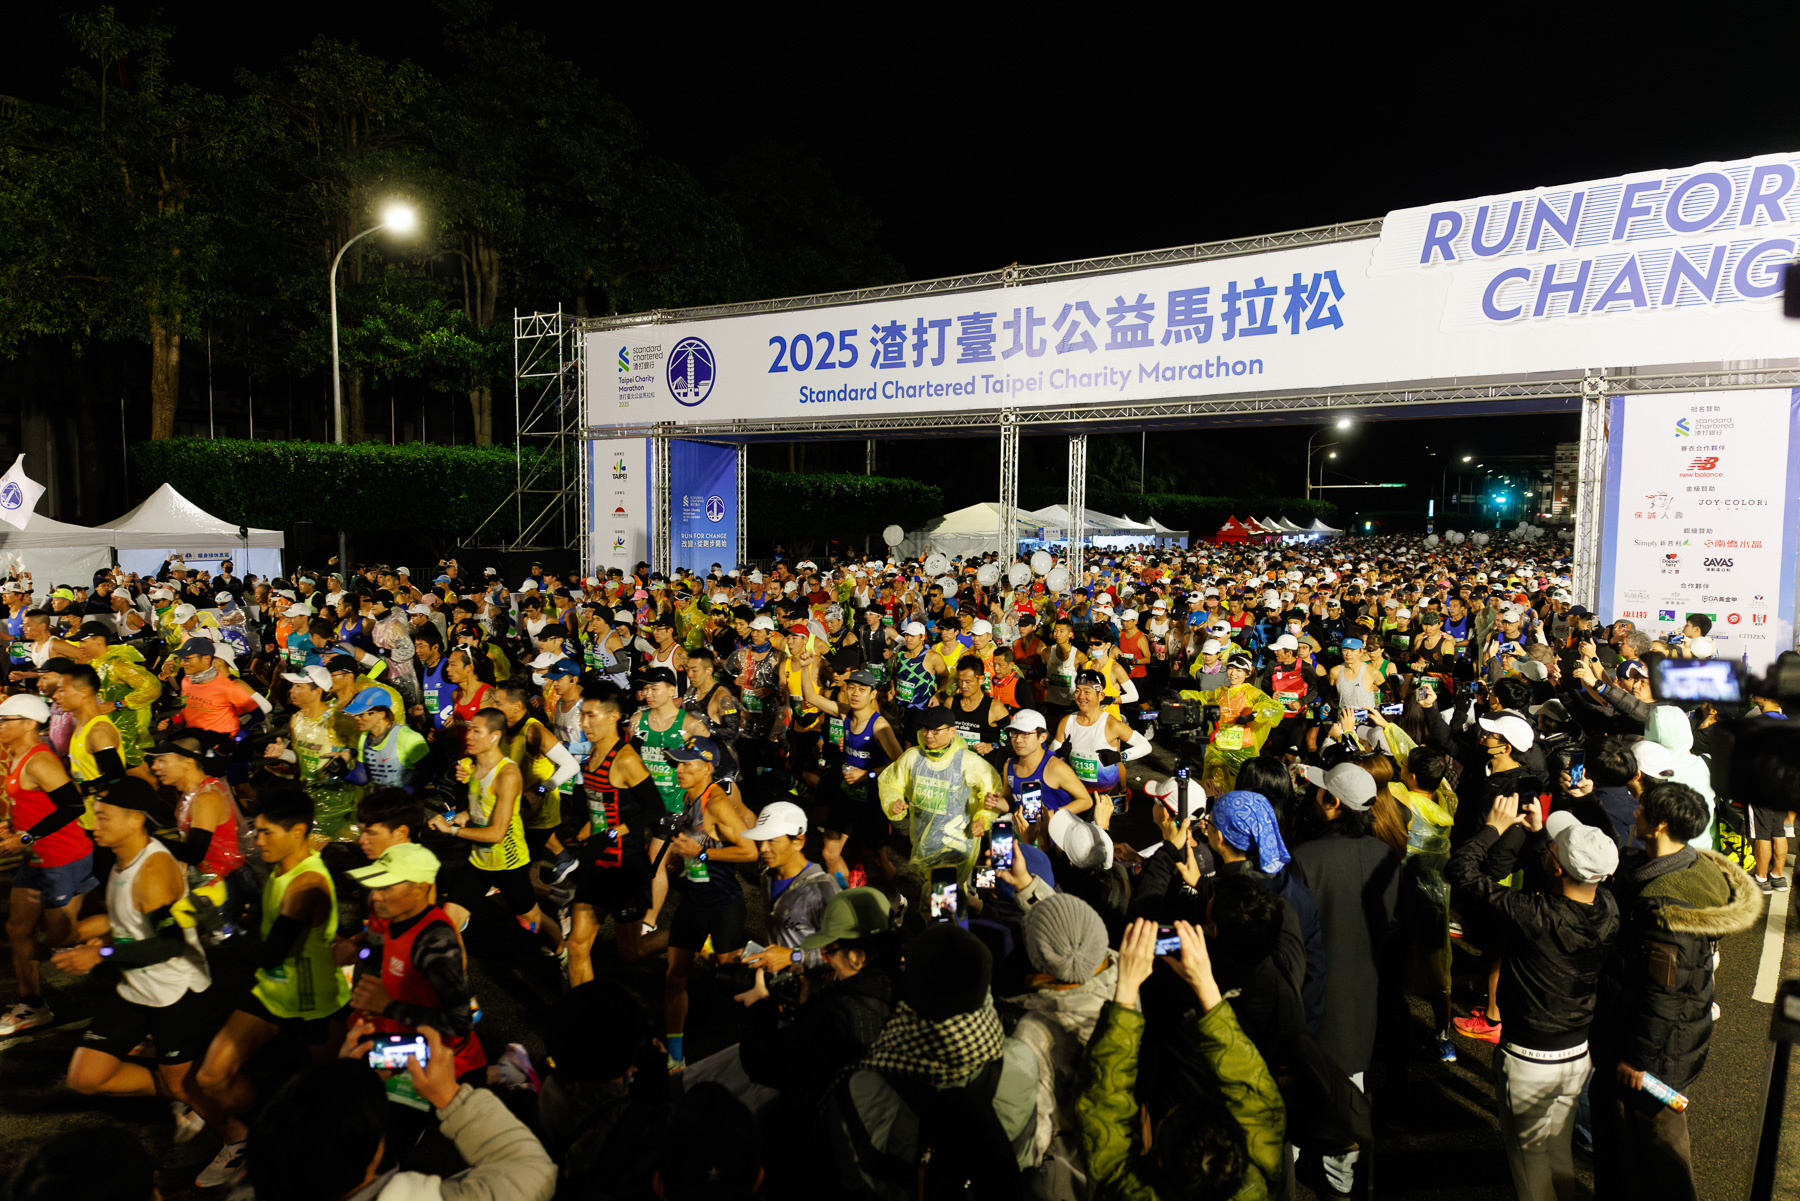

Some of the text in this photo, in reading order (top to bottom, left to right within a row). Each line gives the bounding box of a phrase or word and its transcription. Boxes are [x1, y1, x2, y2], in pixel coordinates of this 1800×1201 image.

[1419, 163, 1798, 264] RUN FOR
[768, 270, 1346, 374] 2025 渣打臺北公益馬拉松
[632, 344, 662, 354] standard
[632, 352, 664, 362] chartered
[632, 361, 655, 371] 渣打銀行
[618, 375, 655, 384] Taipei Charity
[799, 356, 1264, 403] Standard Chartered Taipei Charity Marathon
[618, 384, 645, 393] Marathon
[1694, 422, 1735, 430] chartered
[1634, 511, 1684, 520] 保誠人壽
[693, 532, 705, 540] FOR
[705, 532, 727, 540] CHANGE
[1633, 539, 1658, 548] Simply
[1714, 539, 1763, 549] 南僑水晶
[1703, 557, 1734, 568] SAVAS
[962, 721, 980, 729] balance
[916, 787, 944, 799] 04011
[1521, 1049, 1553, 1059] UNDER
